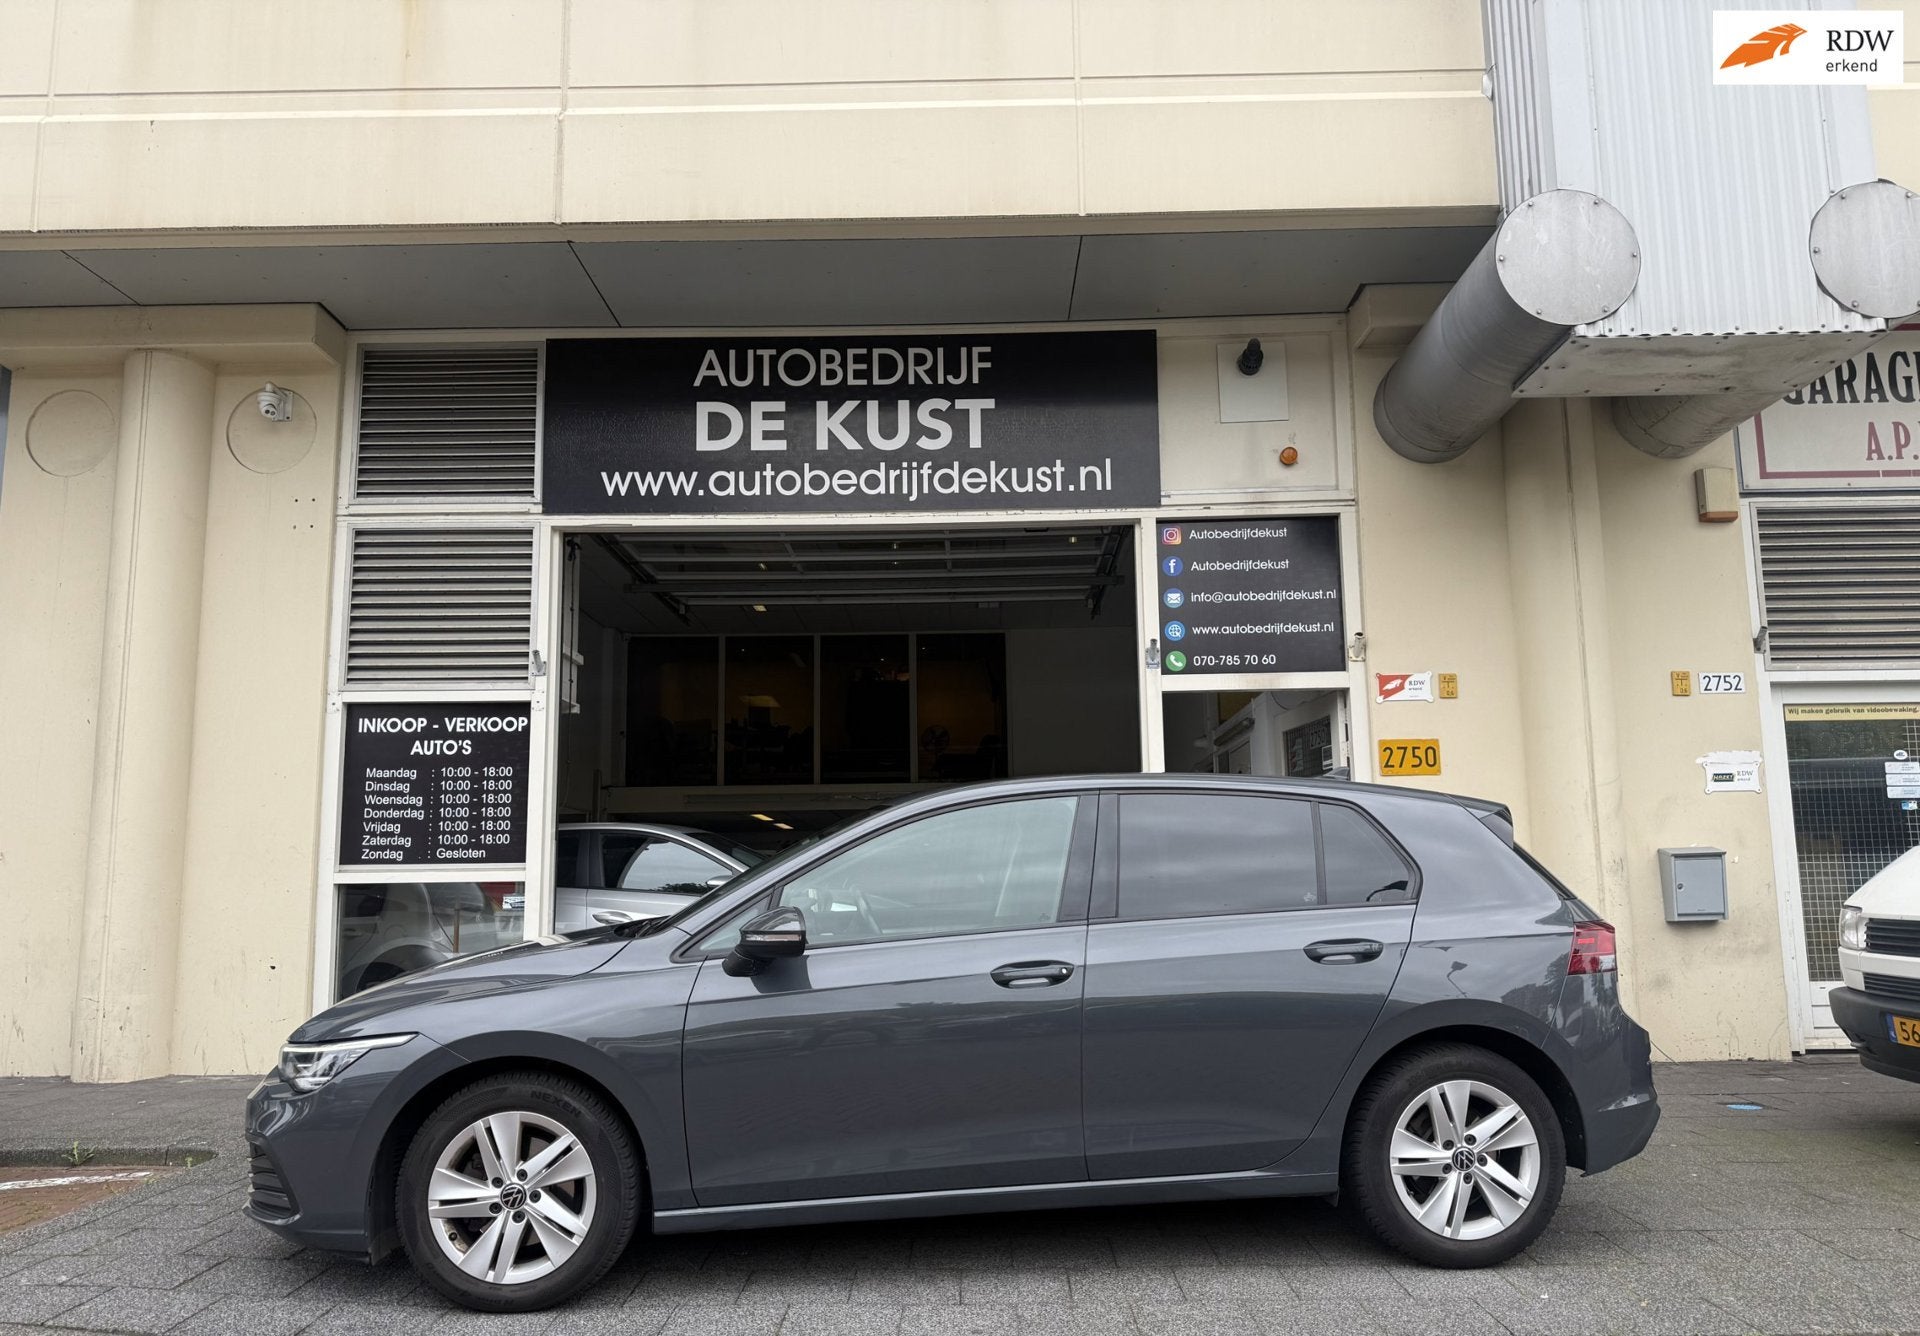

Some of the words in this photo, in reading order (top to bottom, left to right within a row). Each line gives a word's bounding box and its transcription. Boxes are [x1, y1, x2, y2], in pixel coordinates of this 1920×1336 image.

[694, 347, 991, 387] AUTOBEDRIJF
[1782, 350, 1920, 405] ARAG
[696, 402, 787, 451] DE
[816, 399, 995, 451] KUST
[1866, 421, 1920, 460] A.P.
[601, 458, 1111, 501] www.autobedrijfdekust.nl
[1188, 527, 1287, 540] Autobedrijfdekust
[1190, 559, 1289, 572] Autobedrijfdekust
[1190, 589, 1337, 604] info@autobedrijfdekust.nl
[1191, 621, 1334, 635] www.autobedrijfdekust.nl
[1193, 654, 1241, 667] 070-785
[1244, 654, 1259, 665] 70
[1261, 654, 1277, 665] 60
[1702, 674, 1743, 692] 2752
[358, 717, 428, 733] INKOOP
[444, 716, 529, 733] VERKOOP
[410, 739, 472, 756] AUTO'S
[1383, 746, 1436, 768] 2750
[365, 767, 417, 780] Maandag
[440, 766, 472, 778] 10:00
[482, 766, 513, 777] 18:00
[365, 780, 410, 794] Dinsdag
[440, 780, 471, 791] 10:00
[482, 779, 513, 791] 18:00
[364, 794, 423, 807] Woensdag
[439, 793, 470, 805] 10:00
[481, 793, 512, 804] 18:00
[363, 807, 425, 821] Donderdag
[439, 806, 470, 818] 10:00
[480, 806, 512, 818] 18:00
[363, 821, 401, 835] Vrijdag
[438, 820, 469, 832] 10:00
[480, 819, 511, 831] 18:00
[361, 834, 412, 848] Zaterdag
[437, 834, 469, 845] 10:00
[479, 833, 511, 845] 18:00
[361, 848, 404, 862] Zondag
[436, 847, 486, 859] Gesloten
[531, 1090, 581, 1117] NEXEN
